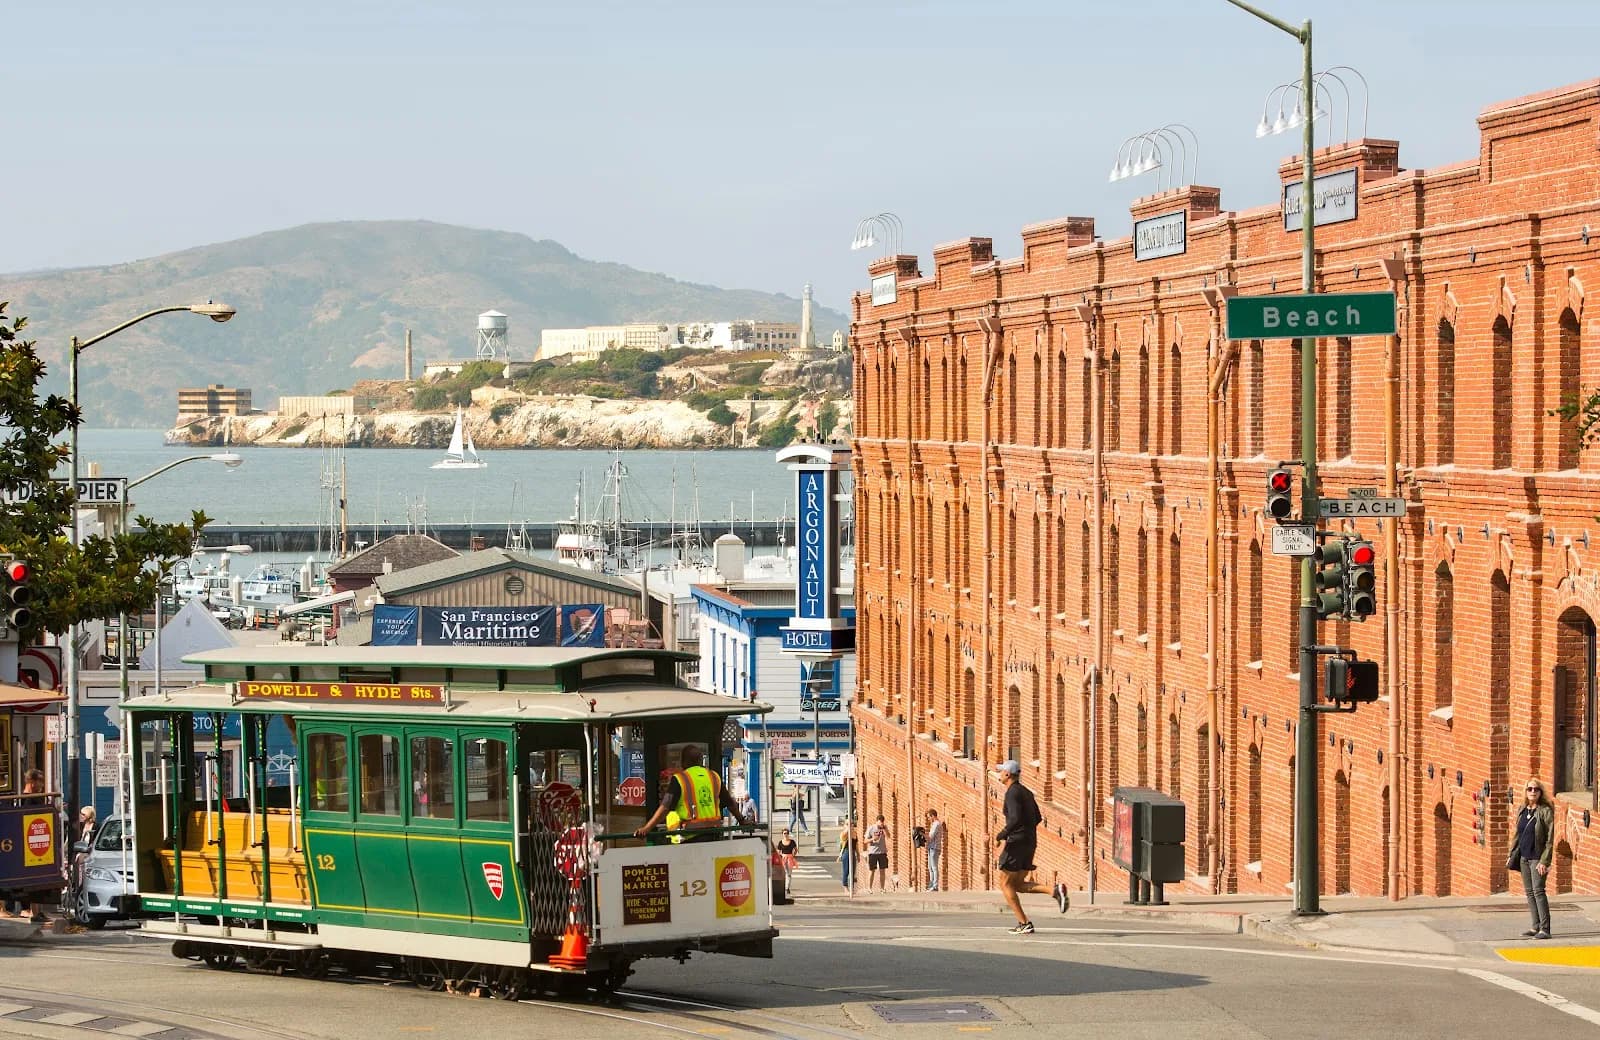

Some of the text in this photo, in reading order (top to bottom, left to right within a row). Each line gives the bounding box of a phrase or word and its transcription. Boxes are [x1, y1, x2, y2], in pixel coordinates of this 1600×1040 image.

[1263, 304, 1360, 328] Beach
[78, 483, 118, 500] PIER
[1359, 489, 1375, 497] 700
[1330, 502, 1396, 514] BEACH
[1298, 528, 1311, 536] CAR
[805, 474, 821, 617] ARGONAUT
[441, 611, 539, 622] San Francisco
[439, 621, 540, 640] Maritime
[786, 632, 828, 647] HOTEL
[247, 683, 434, 699] POWELL & HYDE Sts.
[192, 717, 227, 730] STOE
[621, 786, 646, 798] STOP
[0, 839, 13, 852] 6
[316, 854, 336, 870] 12
[624, 867, 666, 877] POWELL
[624, 880, 668, 890] MARKET
[680, 880, 708, 897] 12
[723, 889, 750, 898] CABLE CAR
